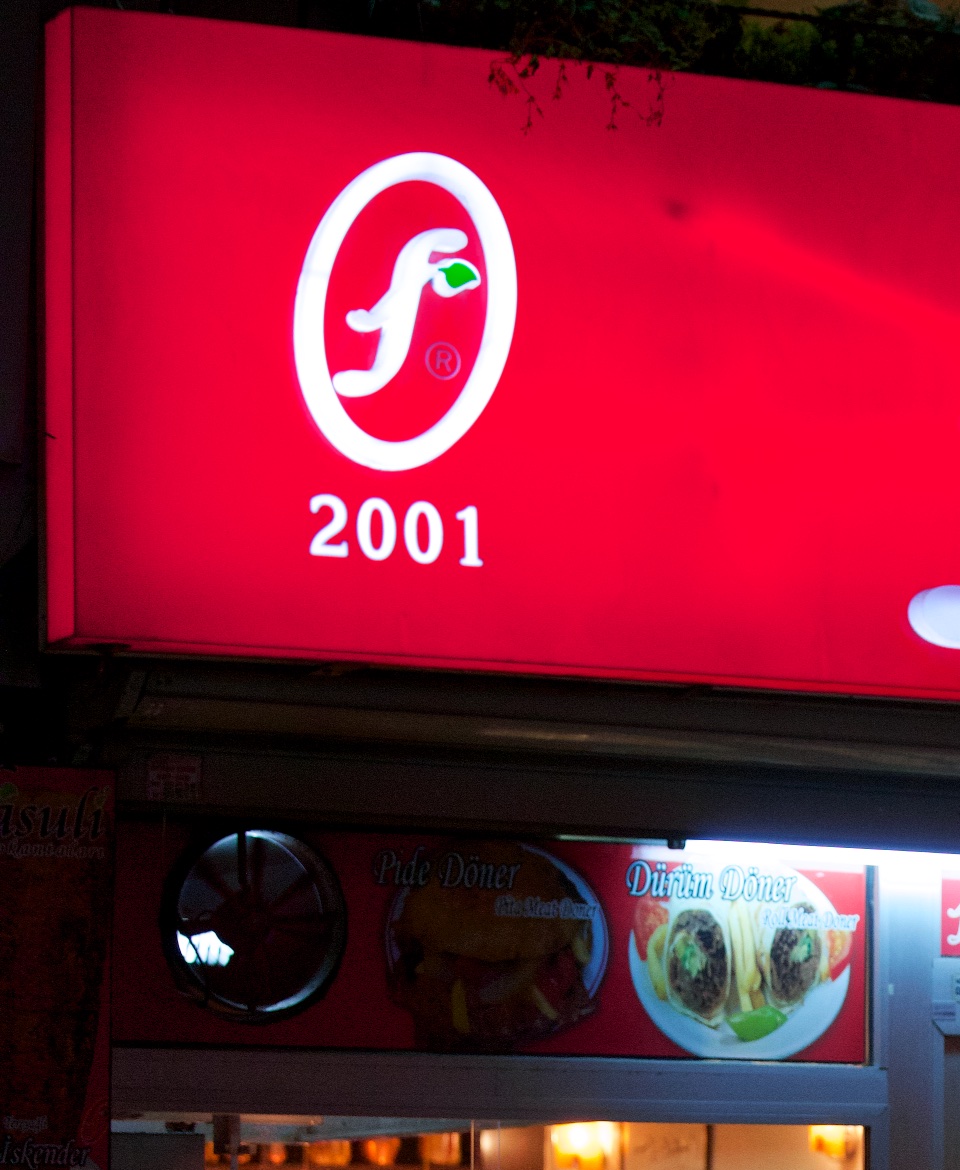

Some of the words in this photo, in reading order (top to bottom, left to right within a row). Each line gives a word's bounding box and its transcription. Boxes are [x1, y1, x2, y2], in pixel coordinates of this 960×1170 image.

[309, 494, 484, 567] 2001
[373, 845, 432, 886] Pide
[438, 851, 521, 890] Döner
[625, 859, 714, 900] Dürüm
[719, 864, 798, 904] Döner
